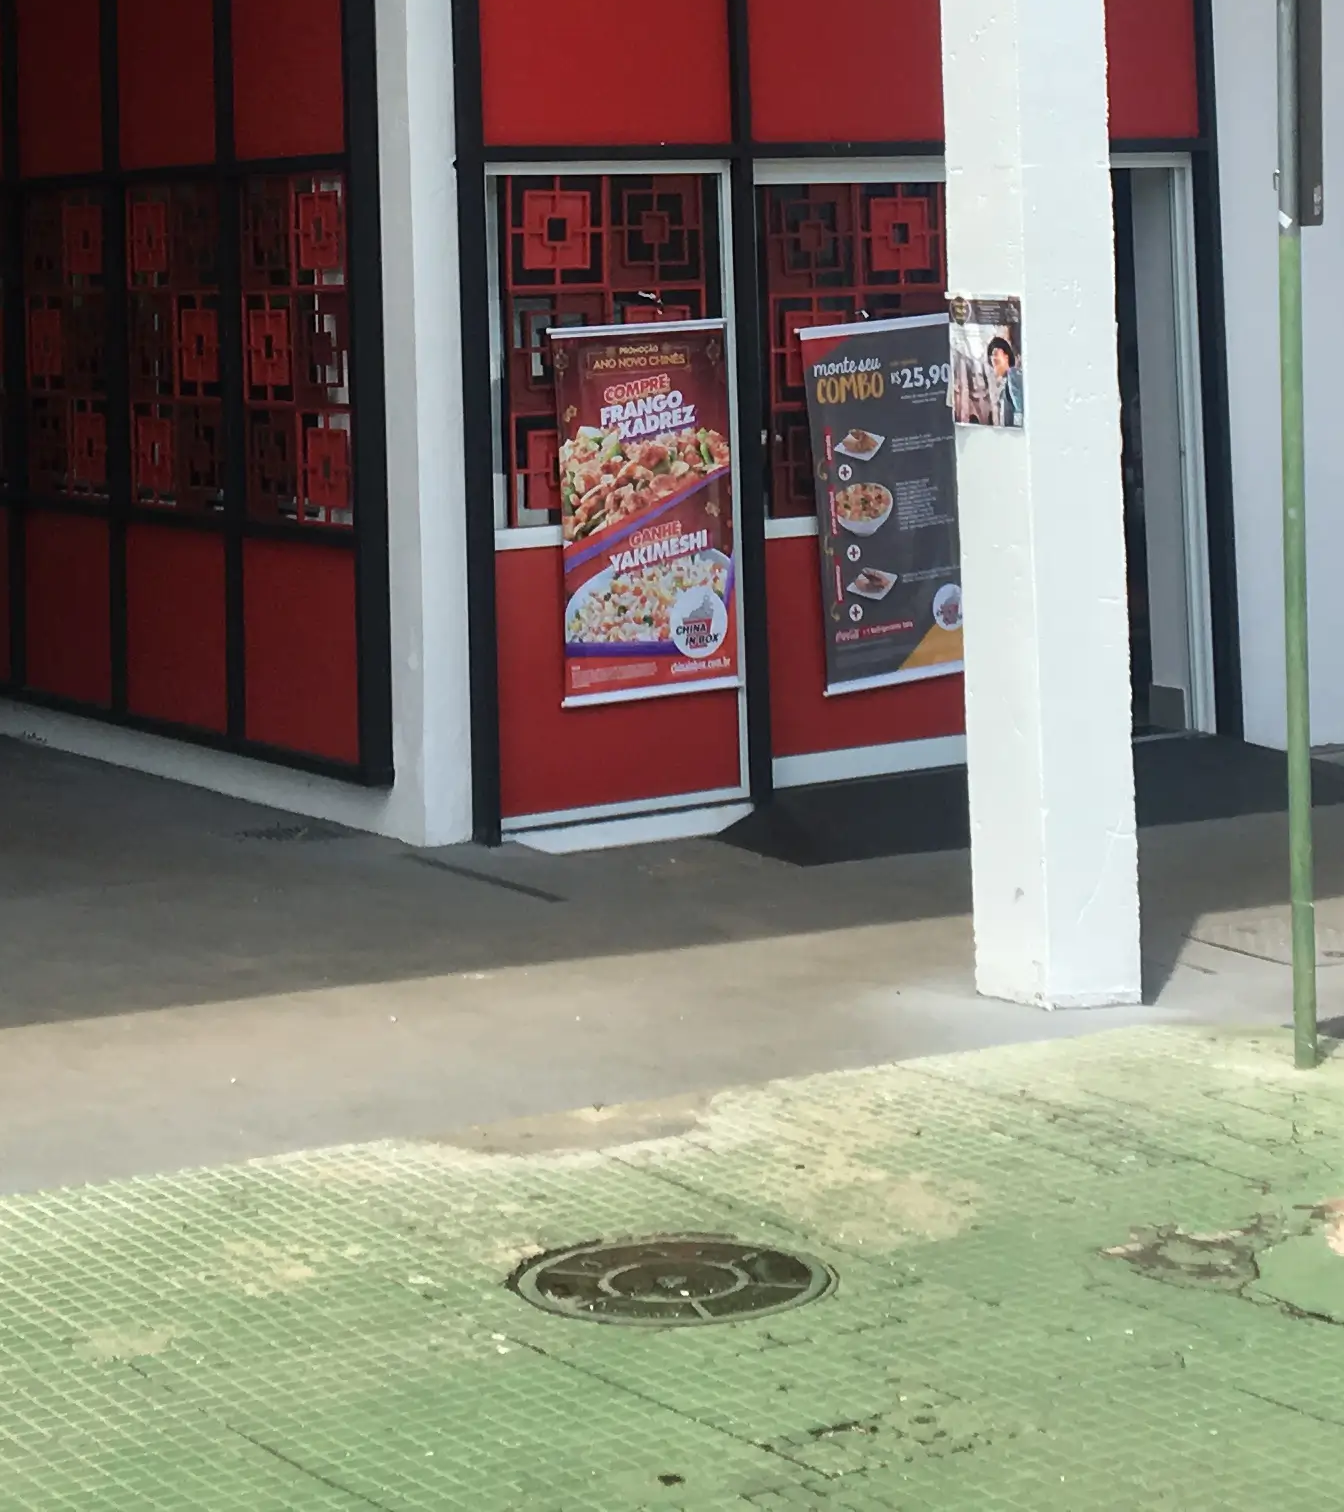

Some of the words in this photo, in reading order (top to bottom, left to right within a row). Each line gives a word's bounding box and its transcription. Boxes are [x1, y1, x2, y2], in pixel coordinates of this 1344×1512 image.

[619, 344, 658, 355] PROMOÇÃO
[593, 357, 616, 370] ANO
[618, 356, 647, 369] NOVO
[649, 352, 685, 367] CHINÊS
[813, 356, 857, 378] monte
[858, 357, 881, 372] seu
[816, 371, 884, 404] COMBO
[600, 390, 683, 426] FRANGO
[618, 404, 695, 439] XADREZ
[609, 529, 708, 572] YAKIMESHI
[676, 624, 706, 635] CHINA
[685, 634, 697, 646] IN
[698, 633, 719, 644] BOX
